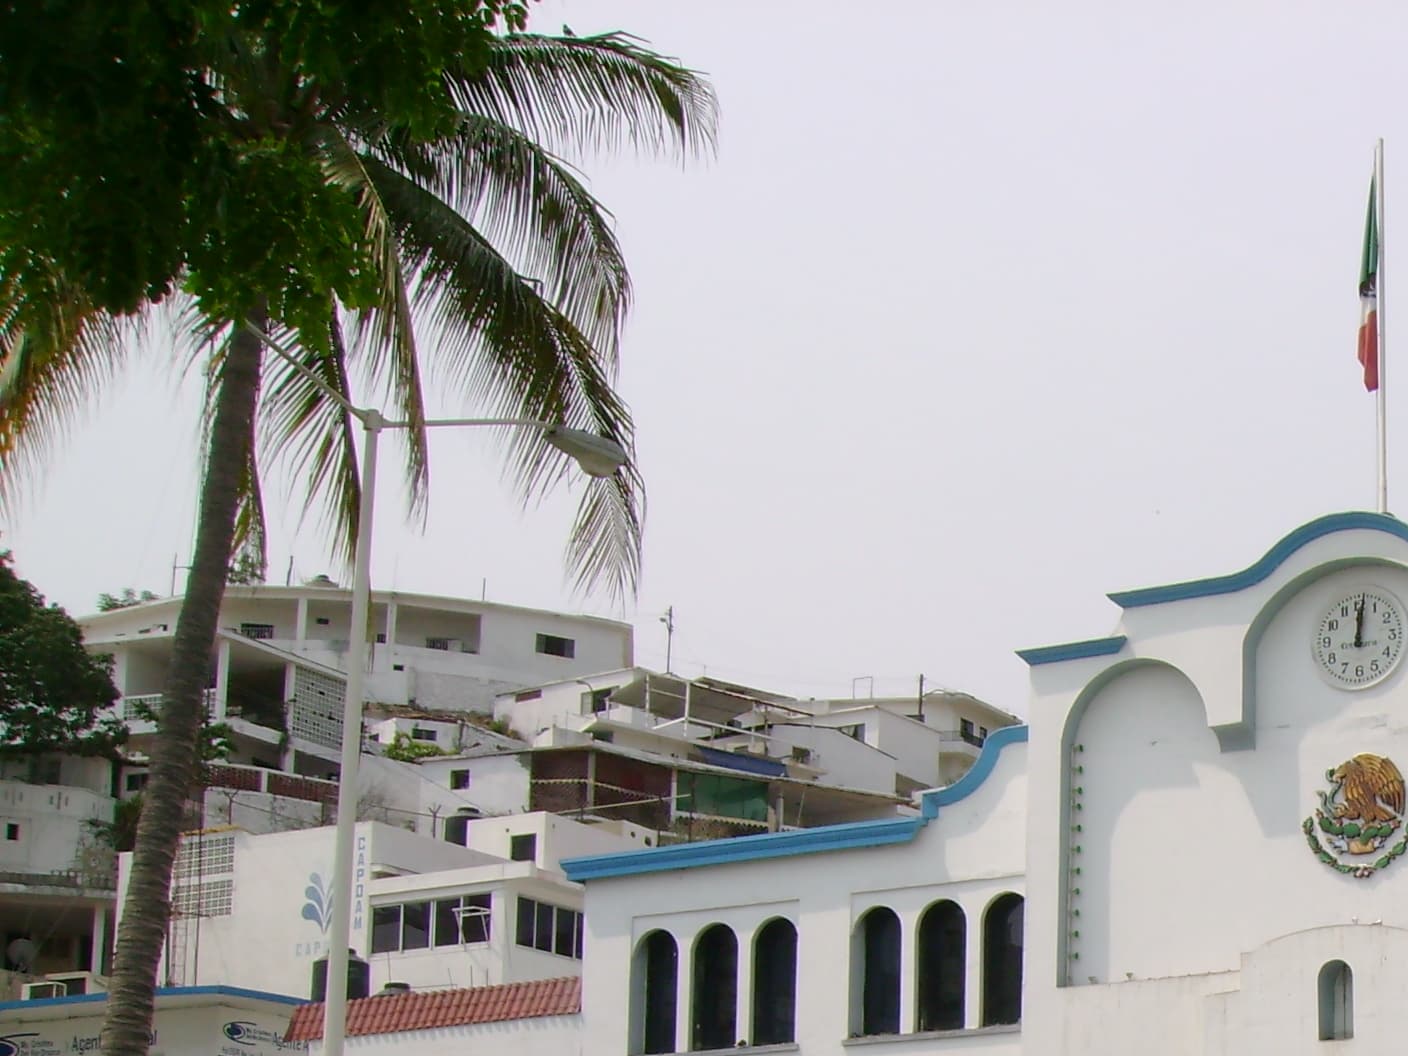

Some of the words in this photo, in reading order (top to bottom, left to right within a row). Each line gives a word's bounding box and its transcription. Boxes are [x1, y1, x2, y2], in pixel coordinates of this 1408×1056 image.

[1341, 605, 1349, 617] 11
[1382, 611, 1391, 624] 2
[1328, 619, 1338, 632] 10
[1388, 628, 1397, 640] 3
[1322, 636, 1331, 648] 9
[1382, 646, 1390, 658] 4
[1328, 652, 1336, 665] 8
[1341, 662, 1349, 674] 7
[1355, 665, 1364, 677] 6
[1370, 659, 1379, 672] 5
